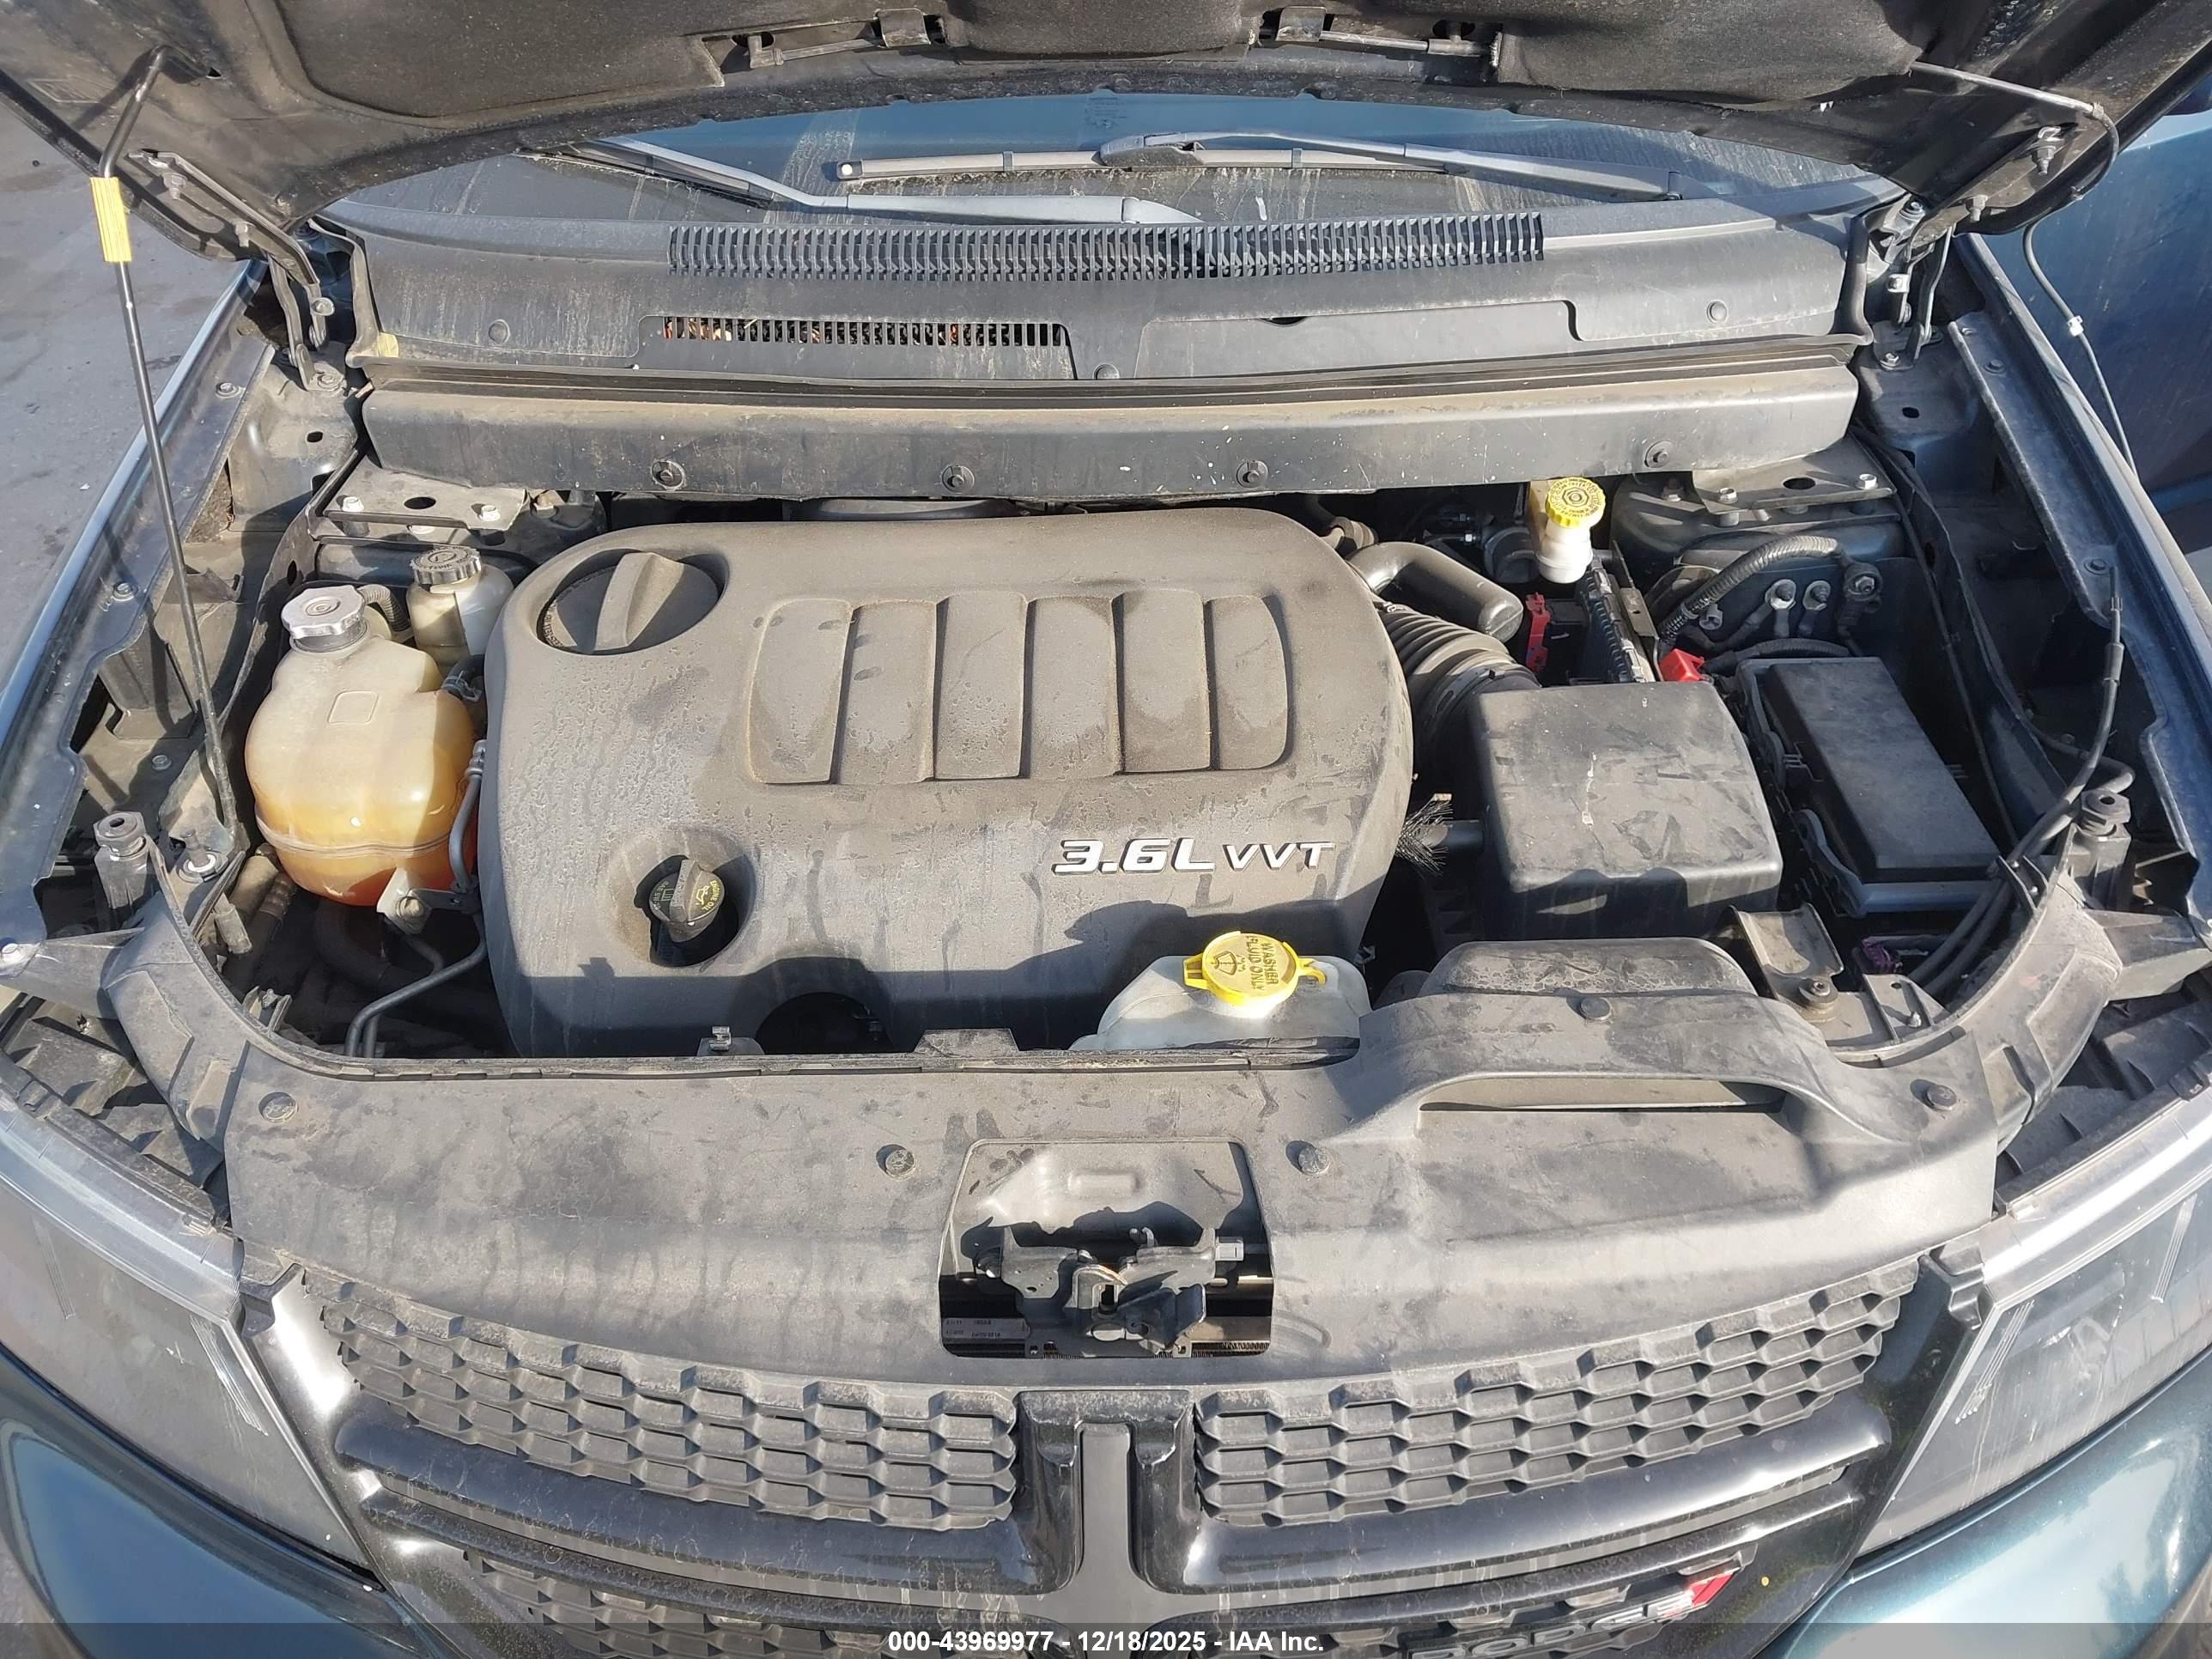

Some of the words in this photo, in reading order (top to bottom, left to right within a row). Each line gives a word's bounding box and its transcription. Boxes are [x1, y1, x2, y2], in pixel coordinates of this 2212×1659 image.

[1052, 838, 1215, 875] 3.6L
[1223, 842, 1335, 871] VVT
[710, 880, 720, 901] ENGINE
[702, 902, 714, 910] OIL
[1246, 935, 1261, 963] FLUID
[1261, 943, 1279, 984] WASHER
[1249, 966, 1265, 990] ONLY
